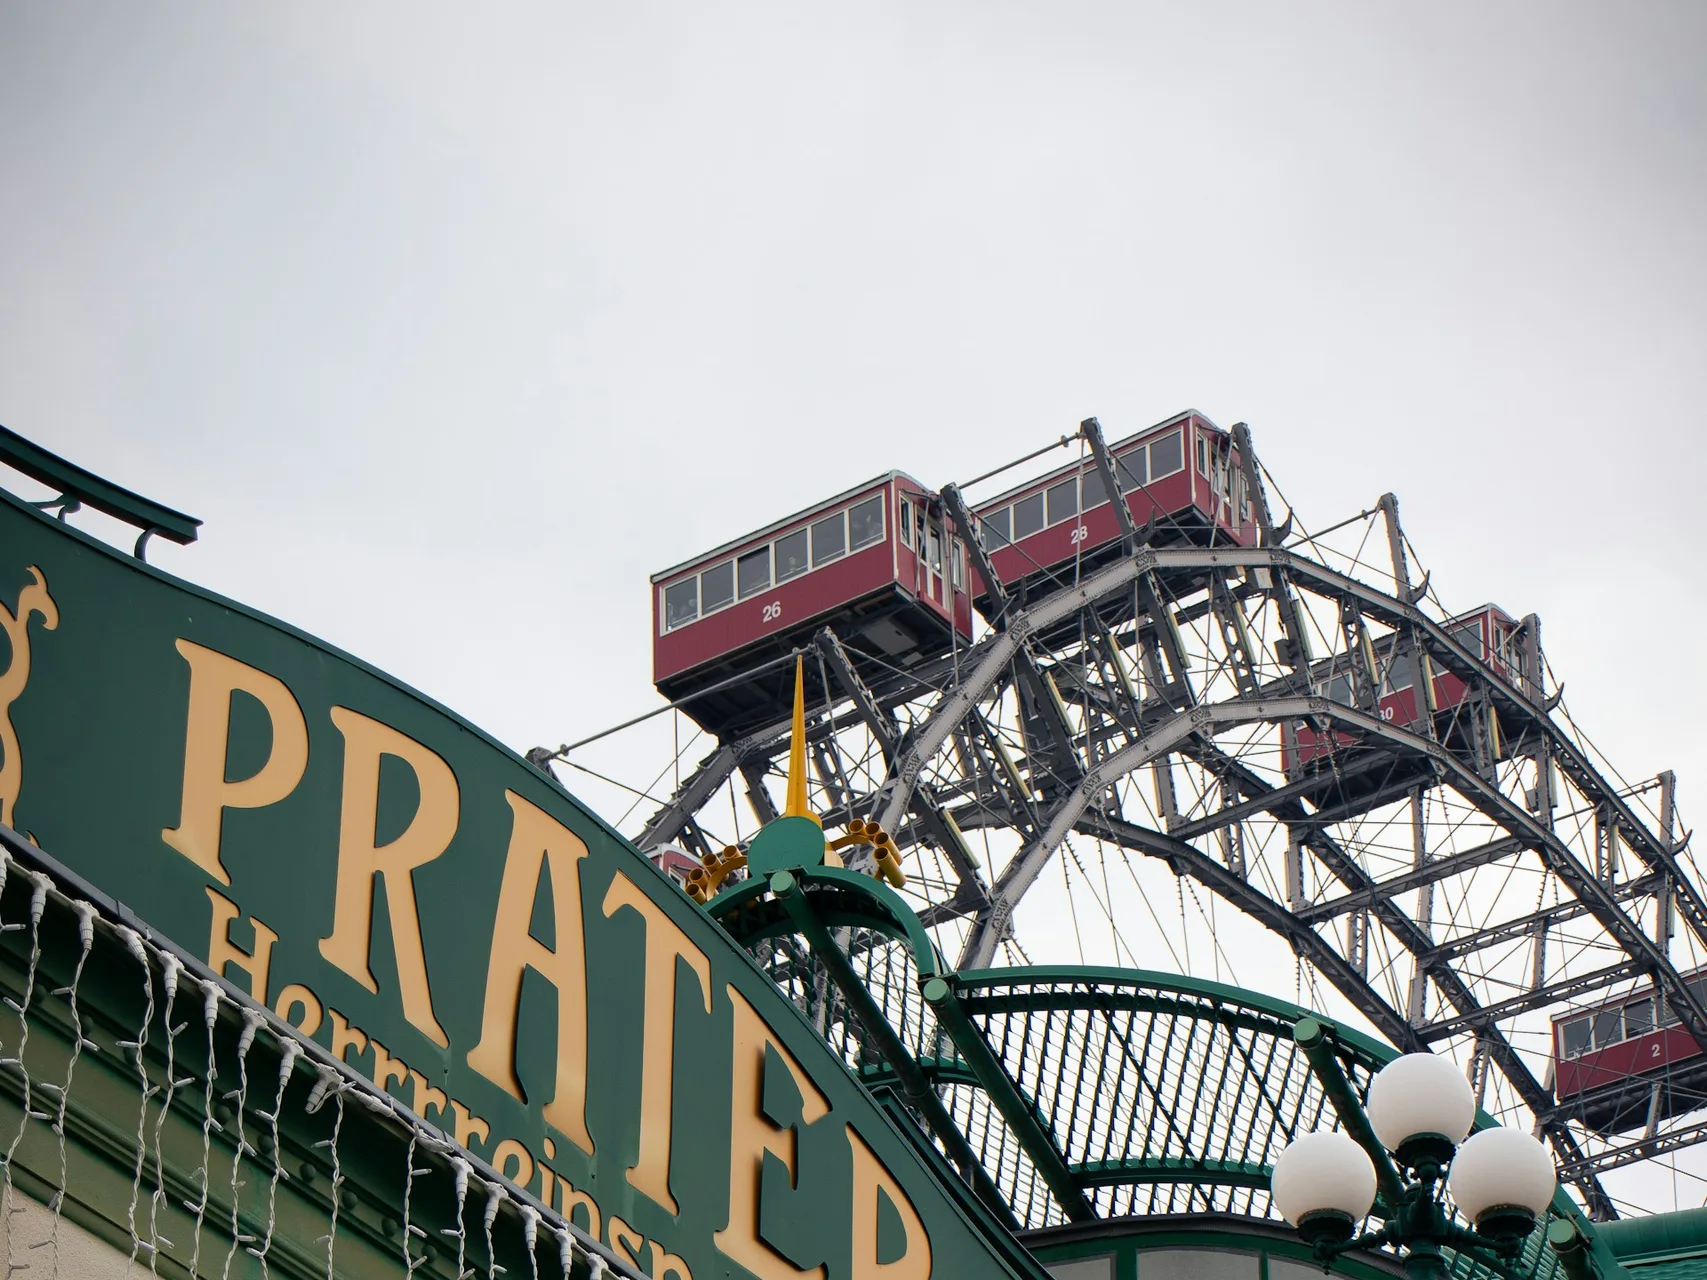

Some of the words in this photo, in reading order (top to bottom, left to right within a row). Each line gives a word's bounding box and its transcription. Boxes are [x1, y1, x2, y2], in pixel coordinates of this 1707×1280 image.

[1070, 525, 1088, 545] 28
[762, 600, 781, 623] 26
[1651, 1043, 1661, 1058] 2
